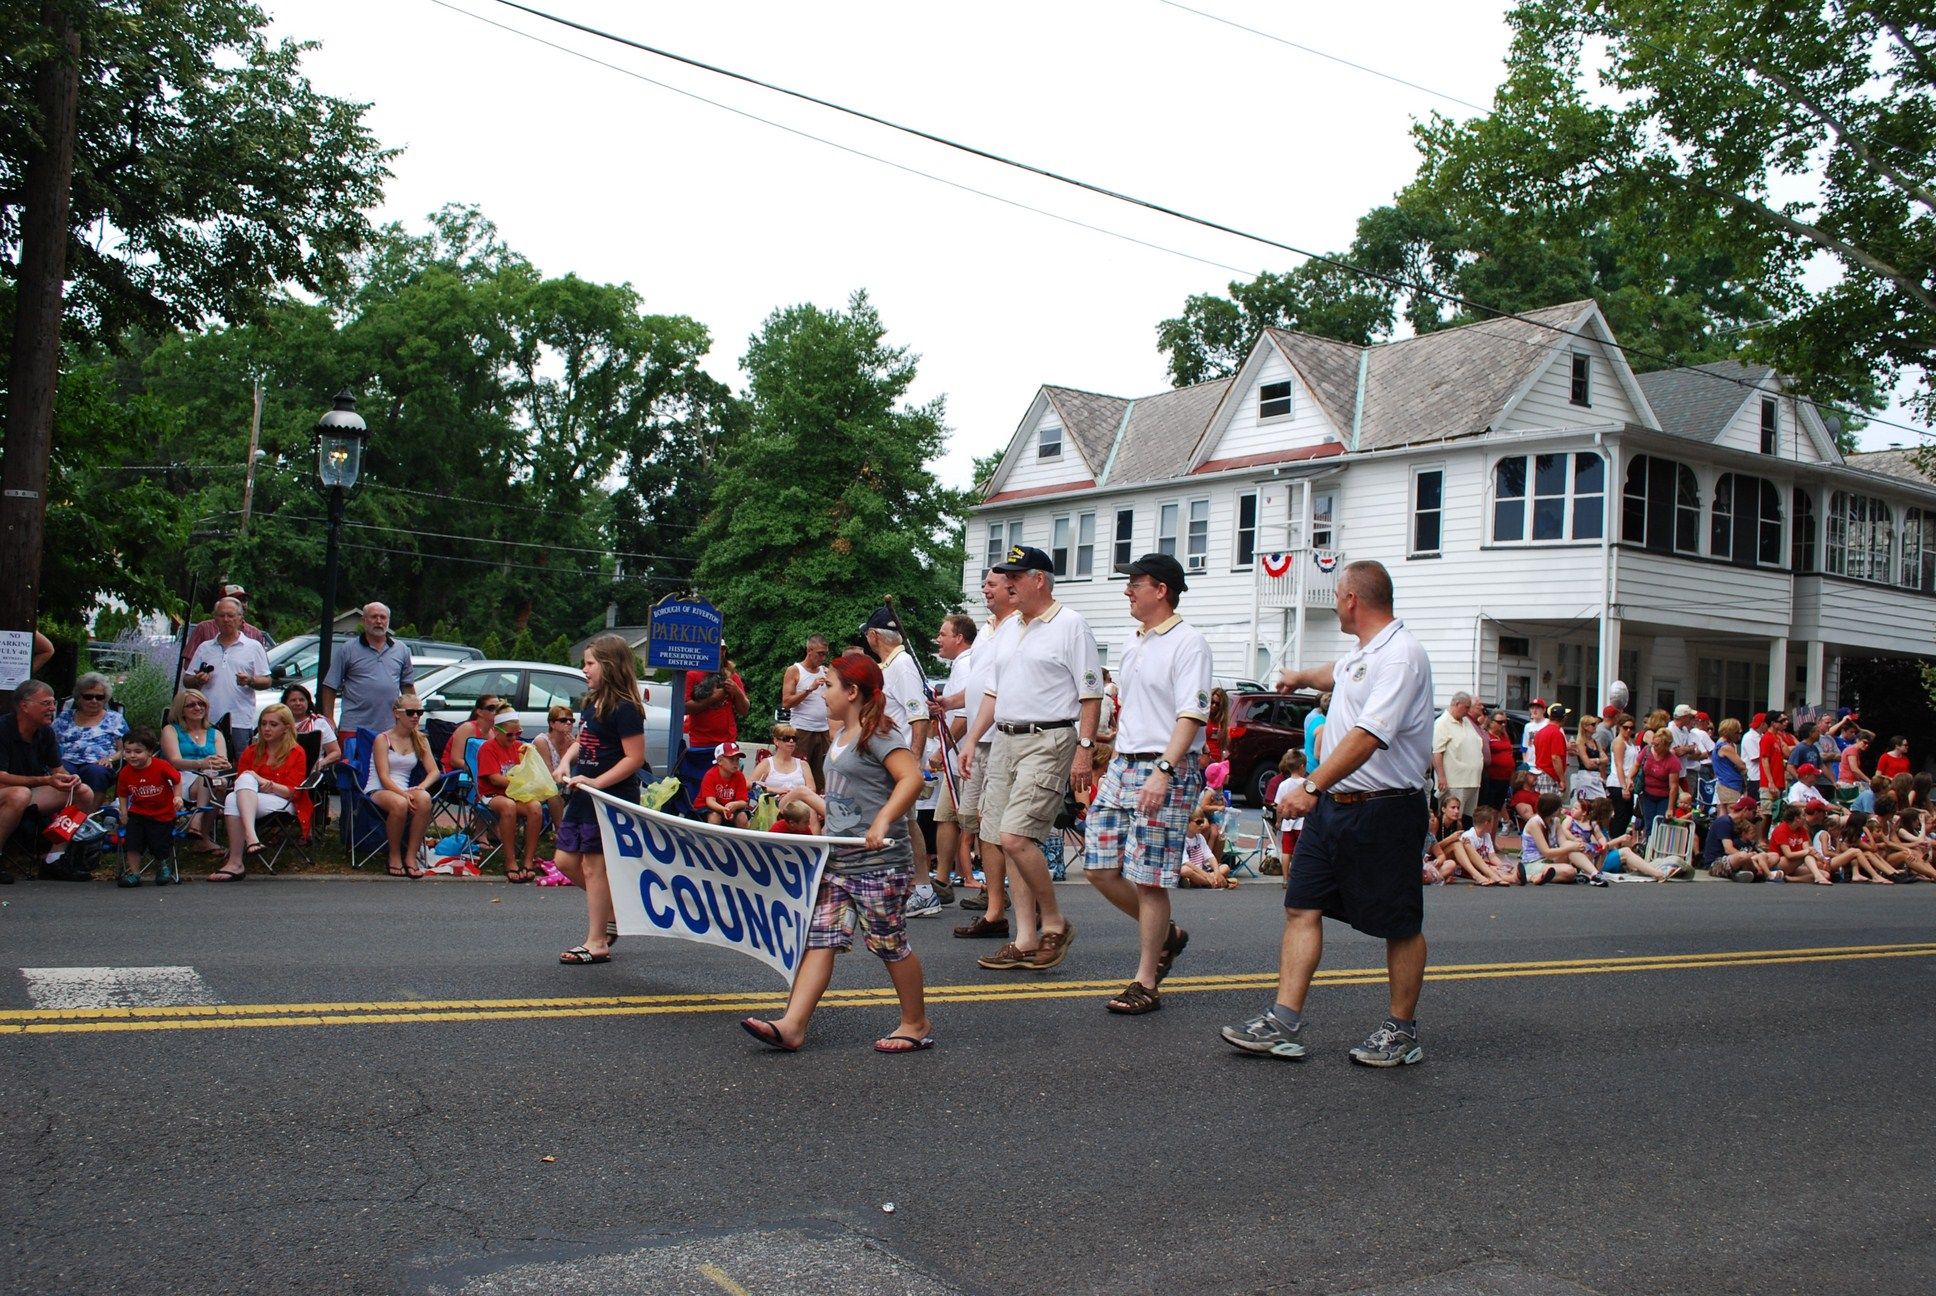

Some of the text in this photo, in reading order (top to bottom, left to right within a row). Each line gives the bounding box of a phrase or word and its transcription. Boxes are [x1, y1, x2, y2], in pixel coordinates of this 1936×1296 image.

[653, 605, 720, 624] BOROUGH OF RIVERTON
[652, 622, 719, 644] PARKING
[659, 652, 710, 661] PRESERVATION
[668, 646, 702, 654] HISTORIC
[668, 659, 700, 667] DISTRICT
[639, 869, 807, 971] COUNCI
